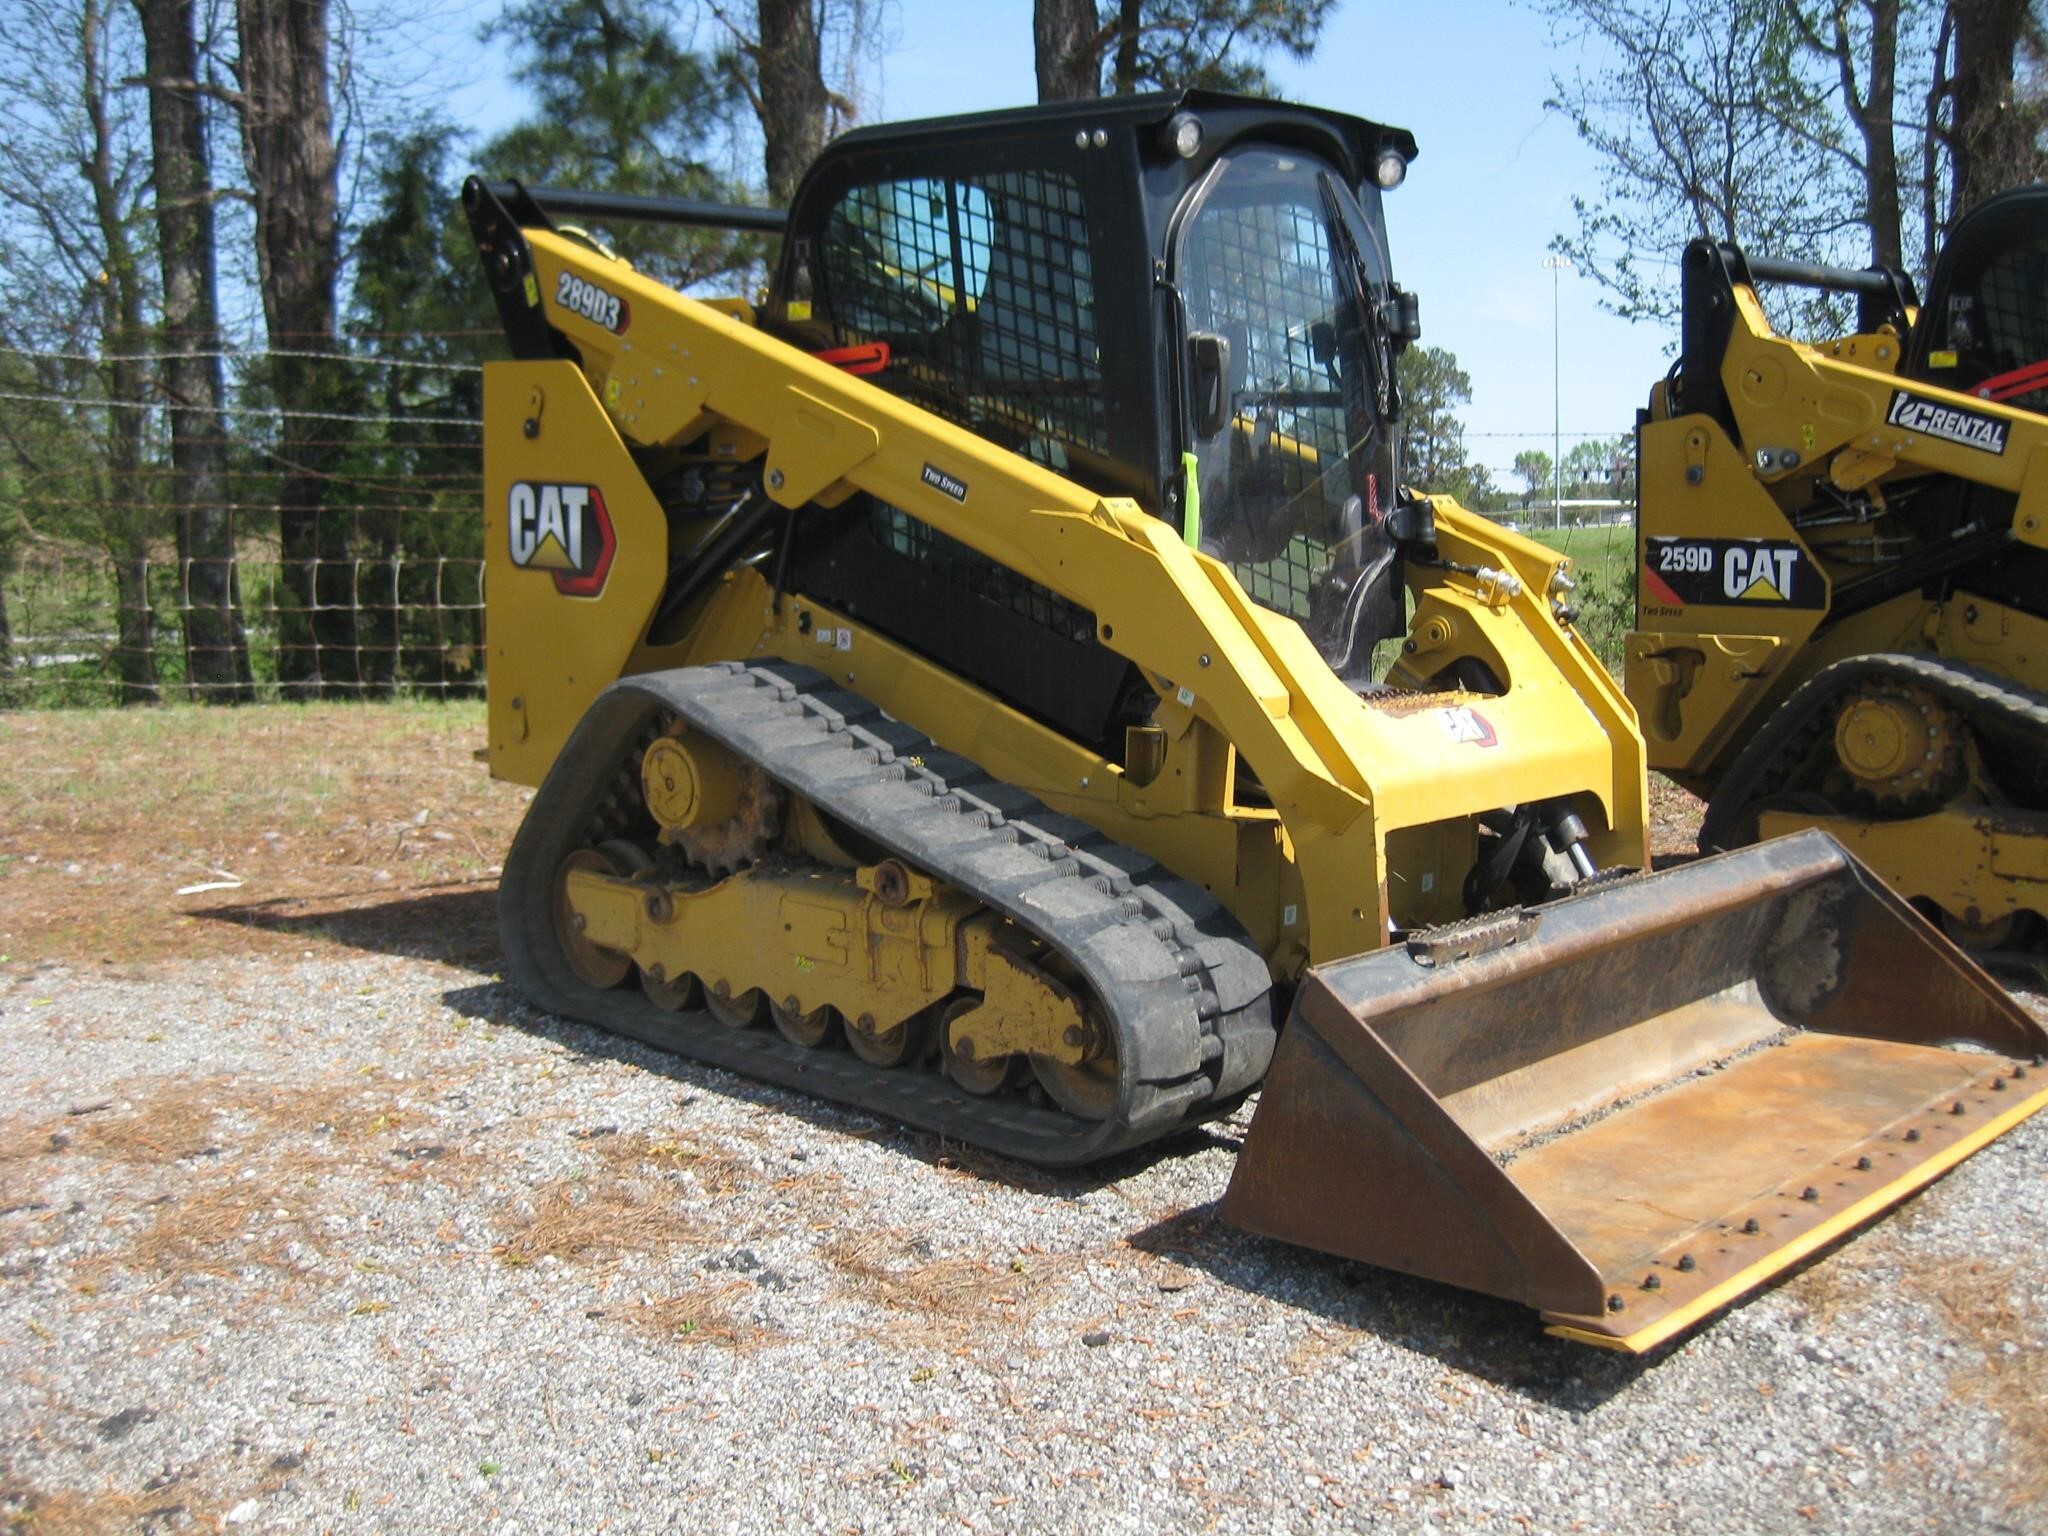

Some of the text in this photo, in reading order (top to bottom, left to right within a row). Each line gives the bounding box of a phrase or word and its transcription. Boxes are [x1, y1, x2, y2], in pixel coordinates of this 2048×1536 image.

[557, 271, 620, 331] 289D3
[1927, 407, 2003, 446] RENTAL
[508, 482, 588, 571] CAT
[1660, 546, 1798, 600] 259D CAT
